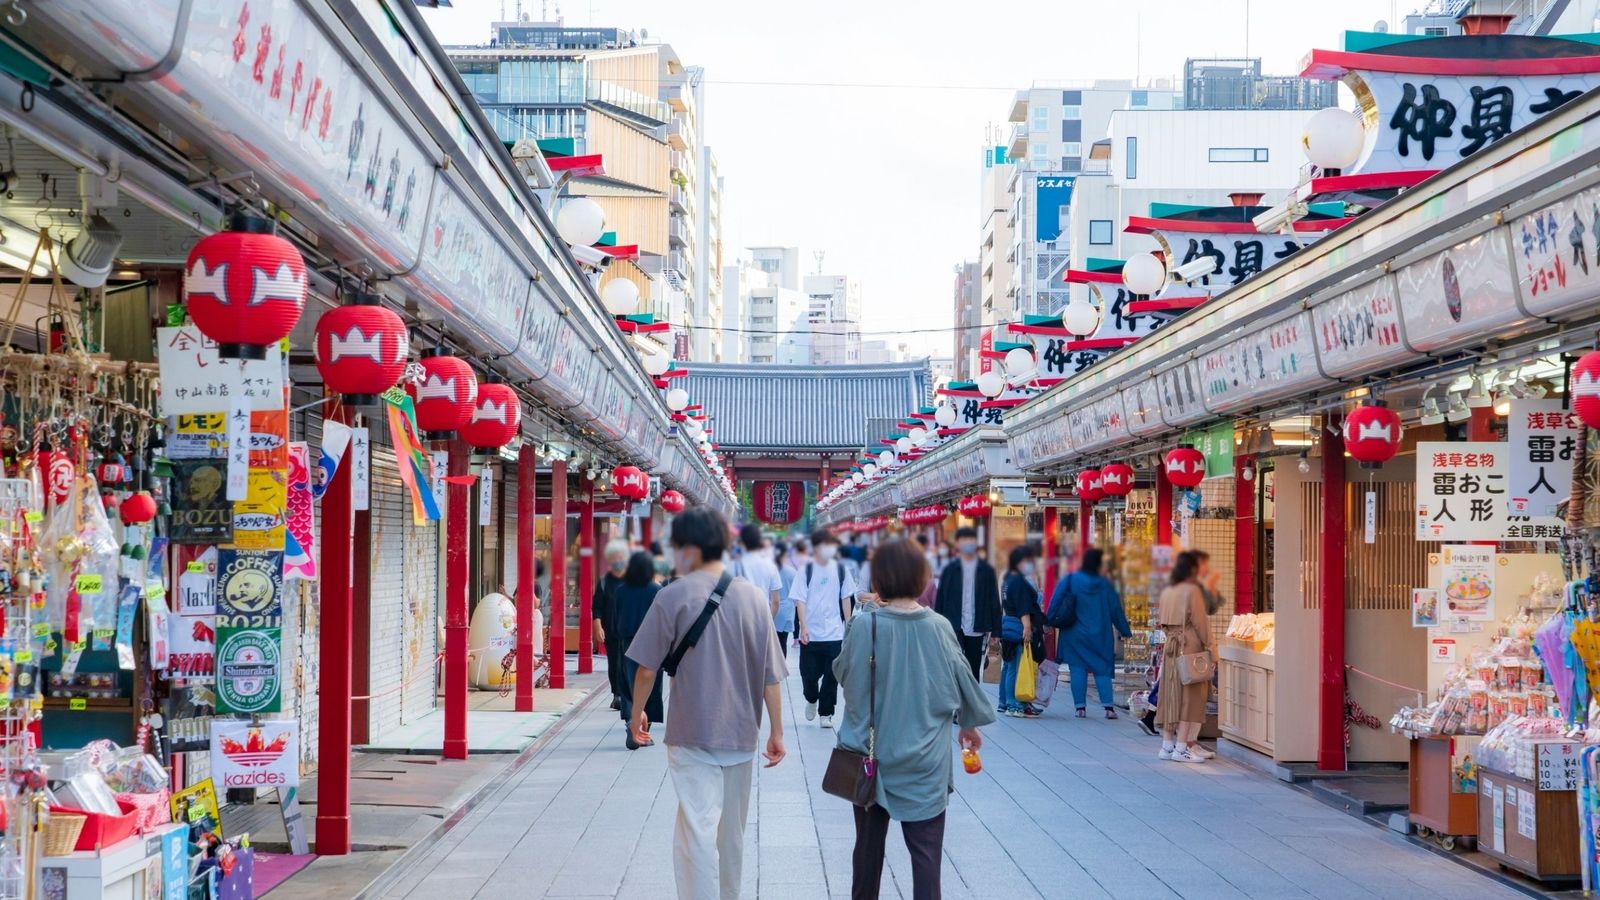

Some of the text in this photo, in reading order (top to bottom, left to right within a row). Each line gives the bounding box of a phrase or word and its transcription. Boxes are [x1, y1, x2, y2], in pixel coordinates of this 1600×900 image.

[1432, 452, 1495, 468] 浅草名物
[1432, 472, 1505, 496] 雷おこ
[172, 509, 233, 526] BOZU
[226, 556, 278, 577] COFFEE
[225, 664, 273, 677] Shimuraken
[225, 684, 272, 703] HENNA OJISAN
[1540, 760, 1550, 768] 10
[224, 770, 286, 786] kazides
[1539, 770, 1551, 779] 10
[1539, 780, 1551, 790] 20
